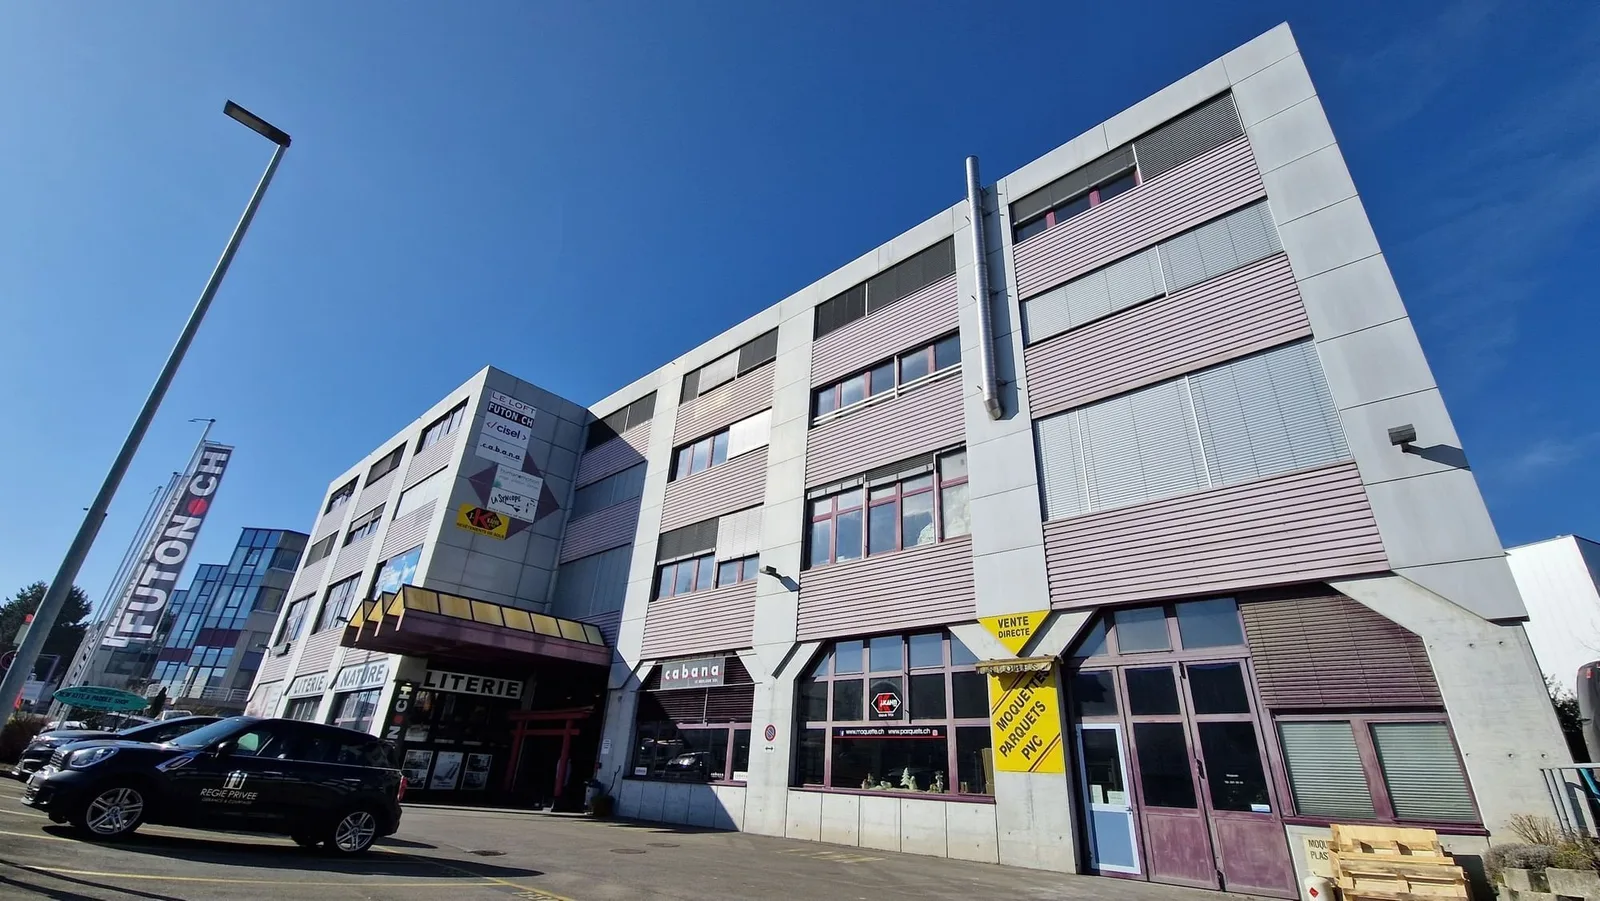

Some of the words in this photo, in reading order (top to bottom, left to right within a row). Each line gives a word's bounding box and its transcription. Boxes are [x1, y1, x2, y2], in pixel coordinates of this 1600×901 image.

[492, 392, 506, 402] LE
[509, 399, 536, 413] LOFT
[997, 616, 1030, 628] VENTE
[998, 628, 1030, 639] DIRECTE
[340, 664, 386, 687] NATURE
[665, 664, 719, 680] cabana
[294, 675, 325, 694] LITERIE
[423, 672, 520, 698] LITERIE
[999, 700, 1046, 757] PARQUETS
[1021, 735, 1043, 760] PVC
[200, 788, 228, 798] REGIE
[228, 790, 258, 800] PRIVEE
